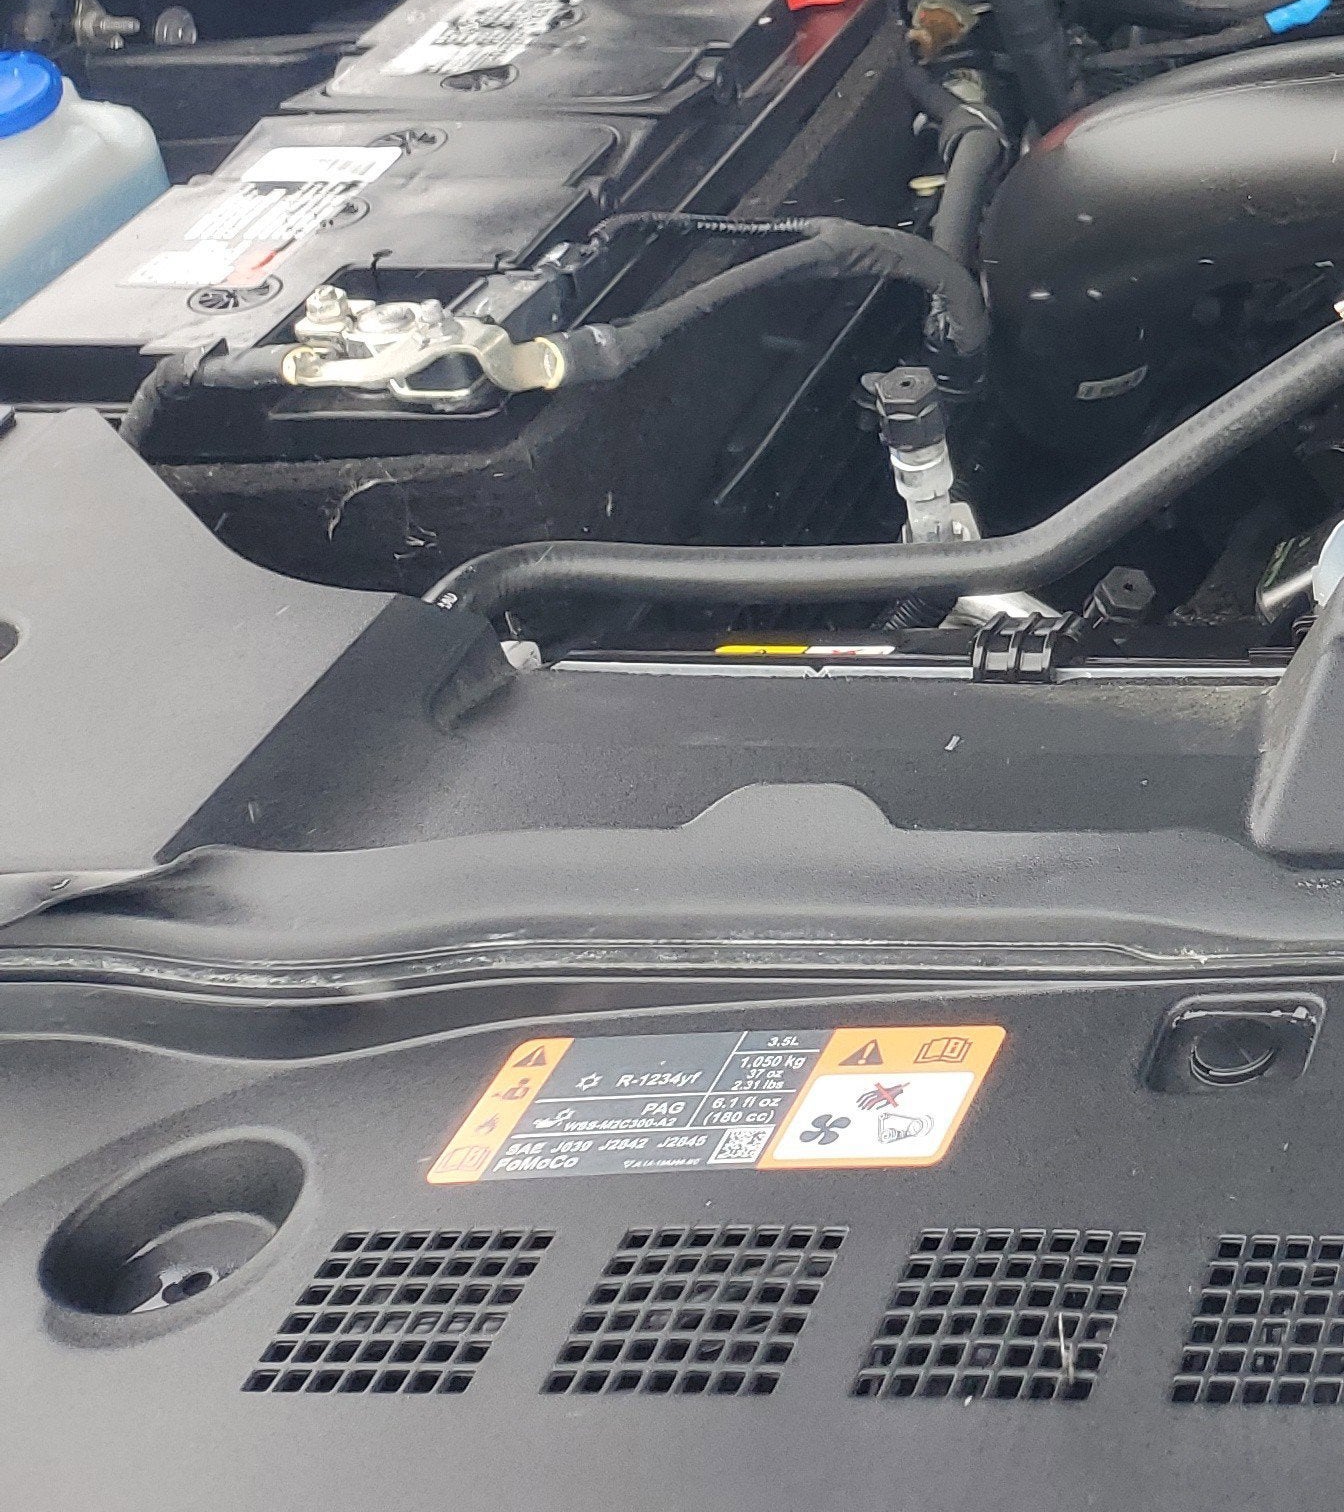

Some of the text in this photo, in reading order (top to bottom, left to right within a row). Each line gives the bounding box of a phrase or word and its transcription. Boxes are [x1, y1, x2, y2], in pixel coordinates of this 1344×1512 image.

[767, 1036, 799, 1047] 3.5L
[740, 1055, 806, 1069] 1.050 kg
[616, 1071, 702, 1088] R-1234yf
[747, 1069, 784, 1079] 37 oz
[731, 1080, 784, 1090] 2.31 lbs
[641, 1101, 686, 1116] PAG
[712, 1096, 782, 1109] 6.1 fl oz
[703, 1110, 774, 1126] (180 cc)
[506, 1141, 547, 1156] SAE
[493, 1154, 579, 1172] FoMoCo
